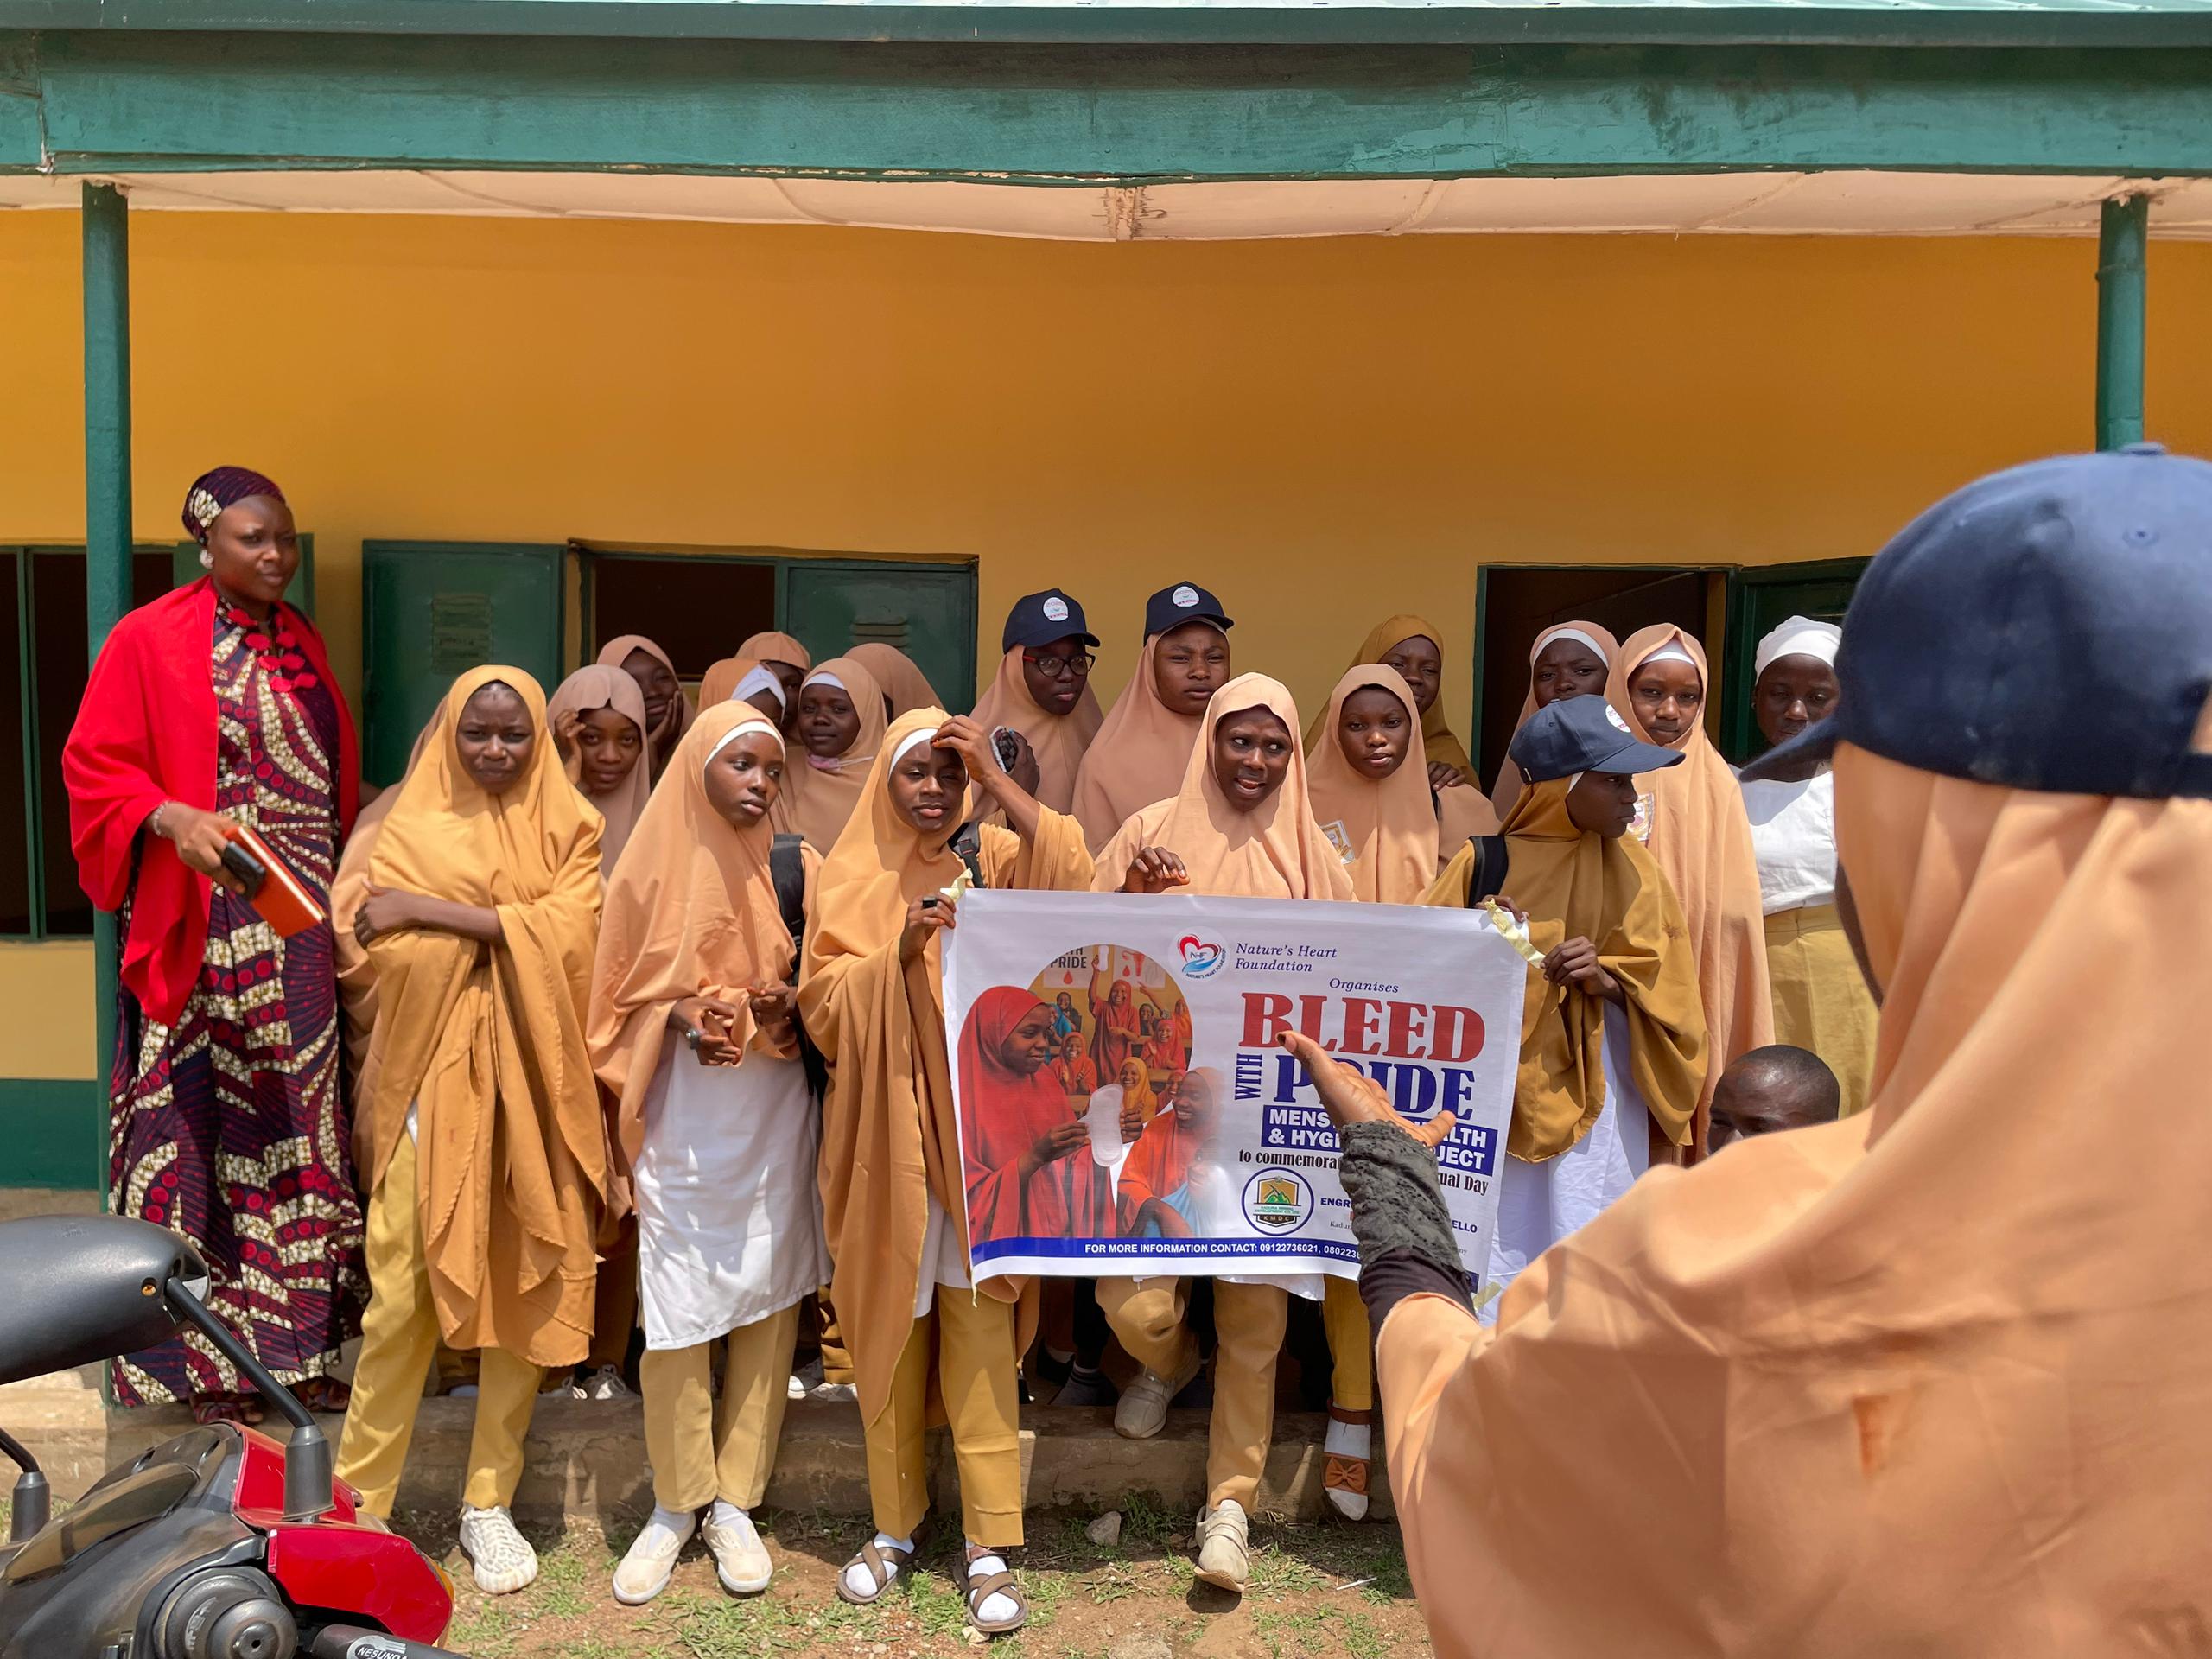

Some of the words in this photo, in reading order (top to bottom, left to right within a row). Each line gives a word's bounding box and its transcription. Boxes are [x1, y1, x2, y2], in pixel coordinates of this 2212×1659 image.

[1235, 957, 1313, 972] Foundation
[1236, 943, 1294, 957] Nature's
[1297, 944, 1338, 958] Heart
[1329, 977, 1400, 994] Organises
[1238, 992, 1486, 1063] BLEED
[1234, 1052, 1262, 1101] WITH
[1273, 1054, 1475, 1122] PIDE
[1268, 1128, 1286, 1145] &
[1291, 1129, 1340, 1148] HYGI
[1435, 1145, 1486, 1170] JECT
[1269, 1109, 1332, 1128] MENS
[1443, 1126, 1486, 1149] LTH
[1239, 1149, 1252, 1163] to
[1255, 1152, 1338, 1170] commemora
[1464, 1175, 1489, 1196] Day
[1451, 1219, 1478, 1234] ELLO
[1084, 1243, 1107, 1254] FOR
[1109, 1243, 1138, 1254] MORE
[1140, 1243, 1208, 1254] INFORMATION
[1210, 1243, 1258, 1253] CONTACT:
[1260, 1243, 1321, 1254] 09122736021,
